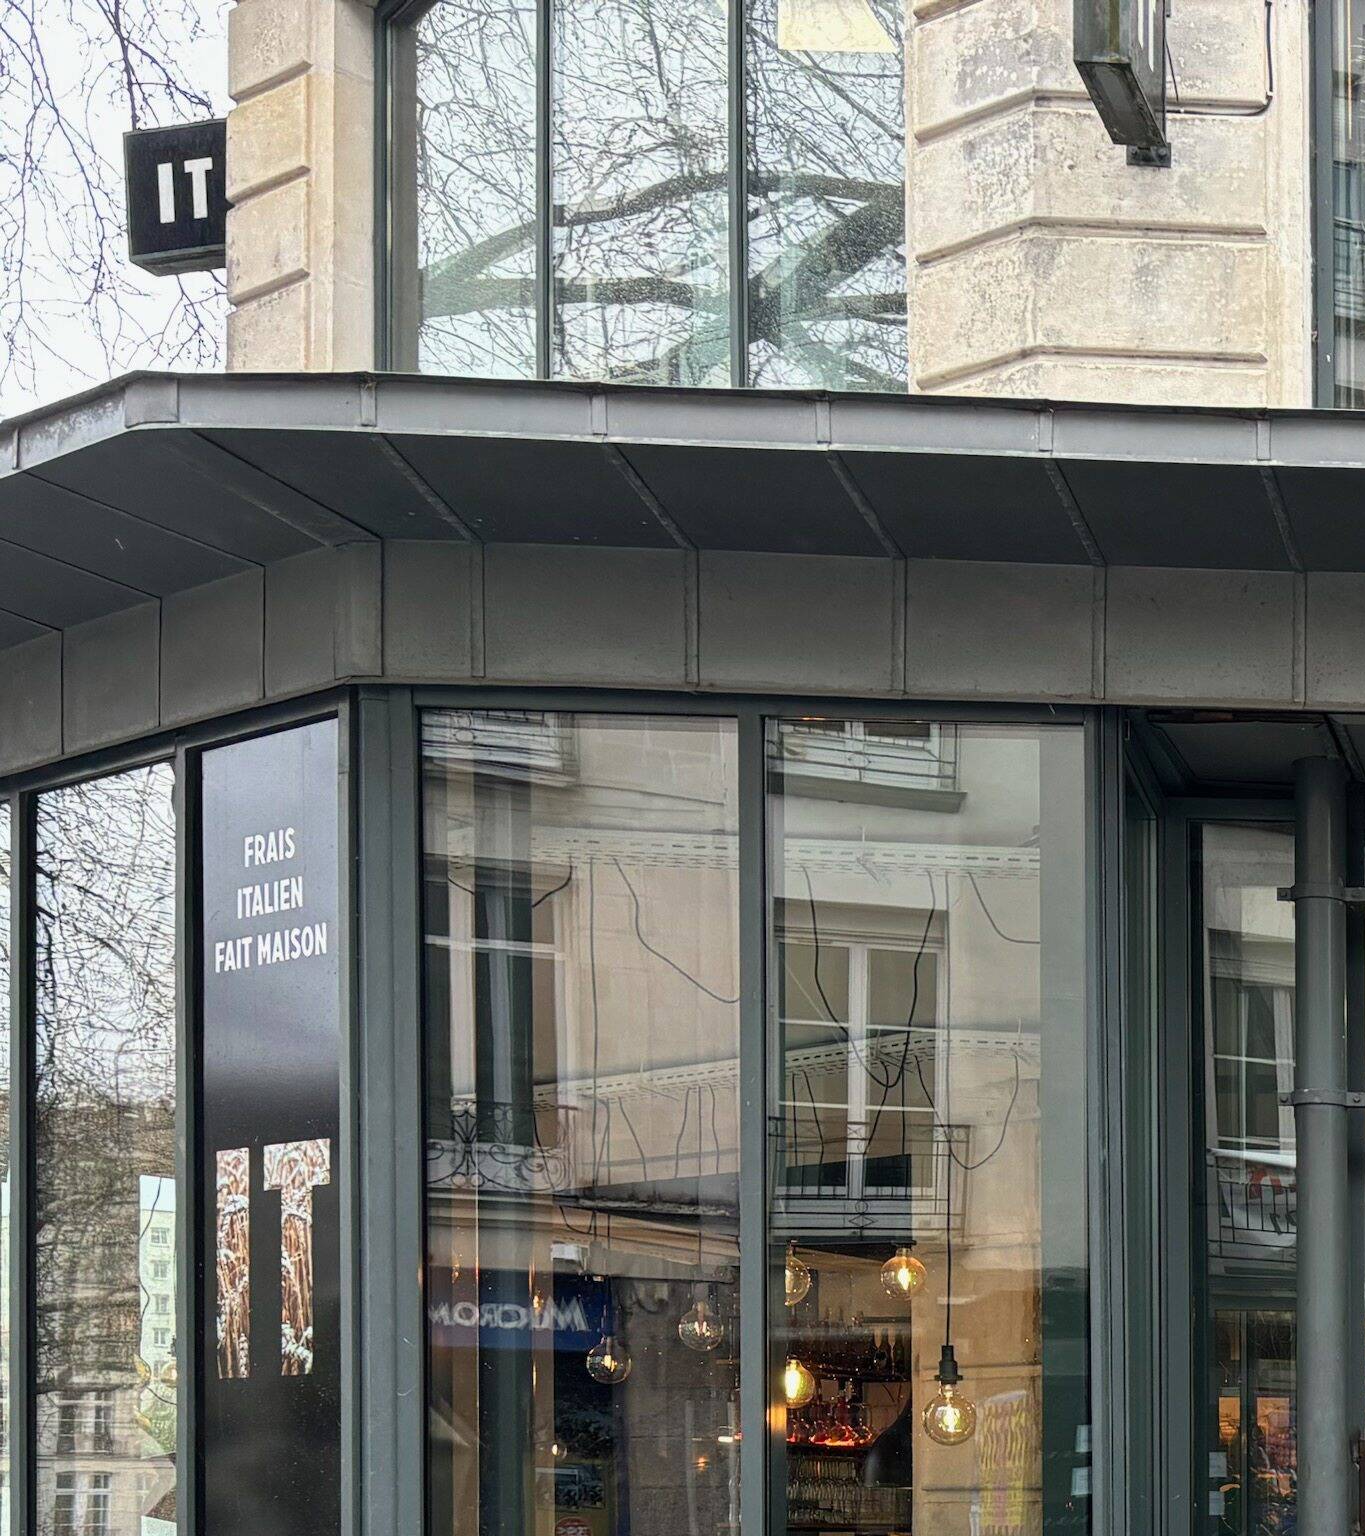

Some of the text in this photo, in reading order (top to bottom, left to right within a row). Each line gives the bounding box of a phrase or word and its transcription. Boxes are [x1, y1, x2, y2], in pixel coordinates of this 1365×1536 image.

[156, 156, 214, 225] IT
[243, 827, 296, 868] FRAIS
[236, 876, 304, 920] ITALIEN
[214, 922, 329, 974] FAIT MAISON
[214, 1138, 332, 1380] IT
